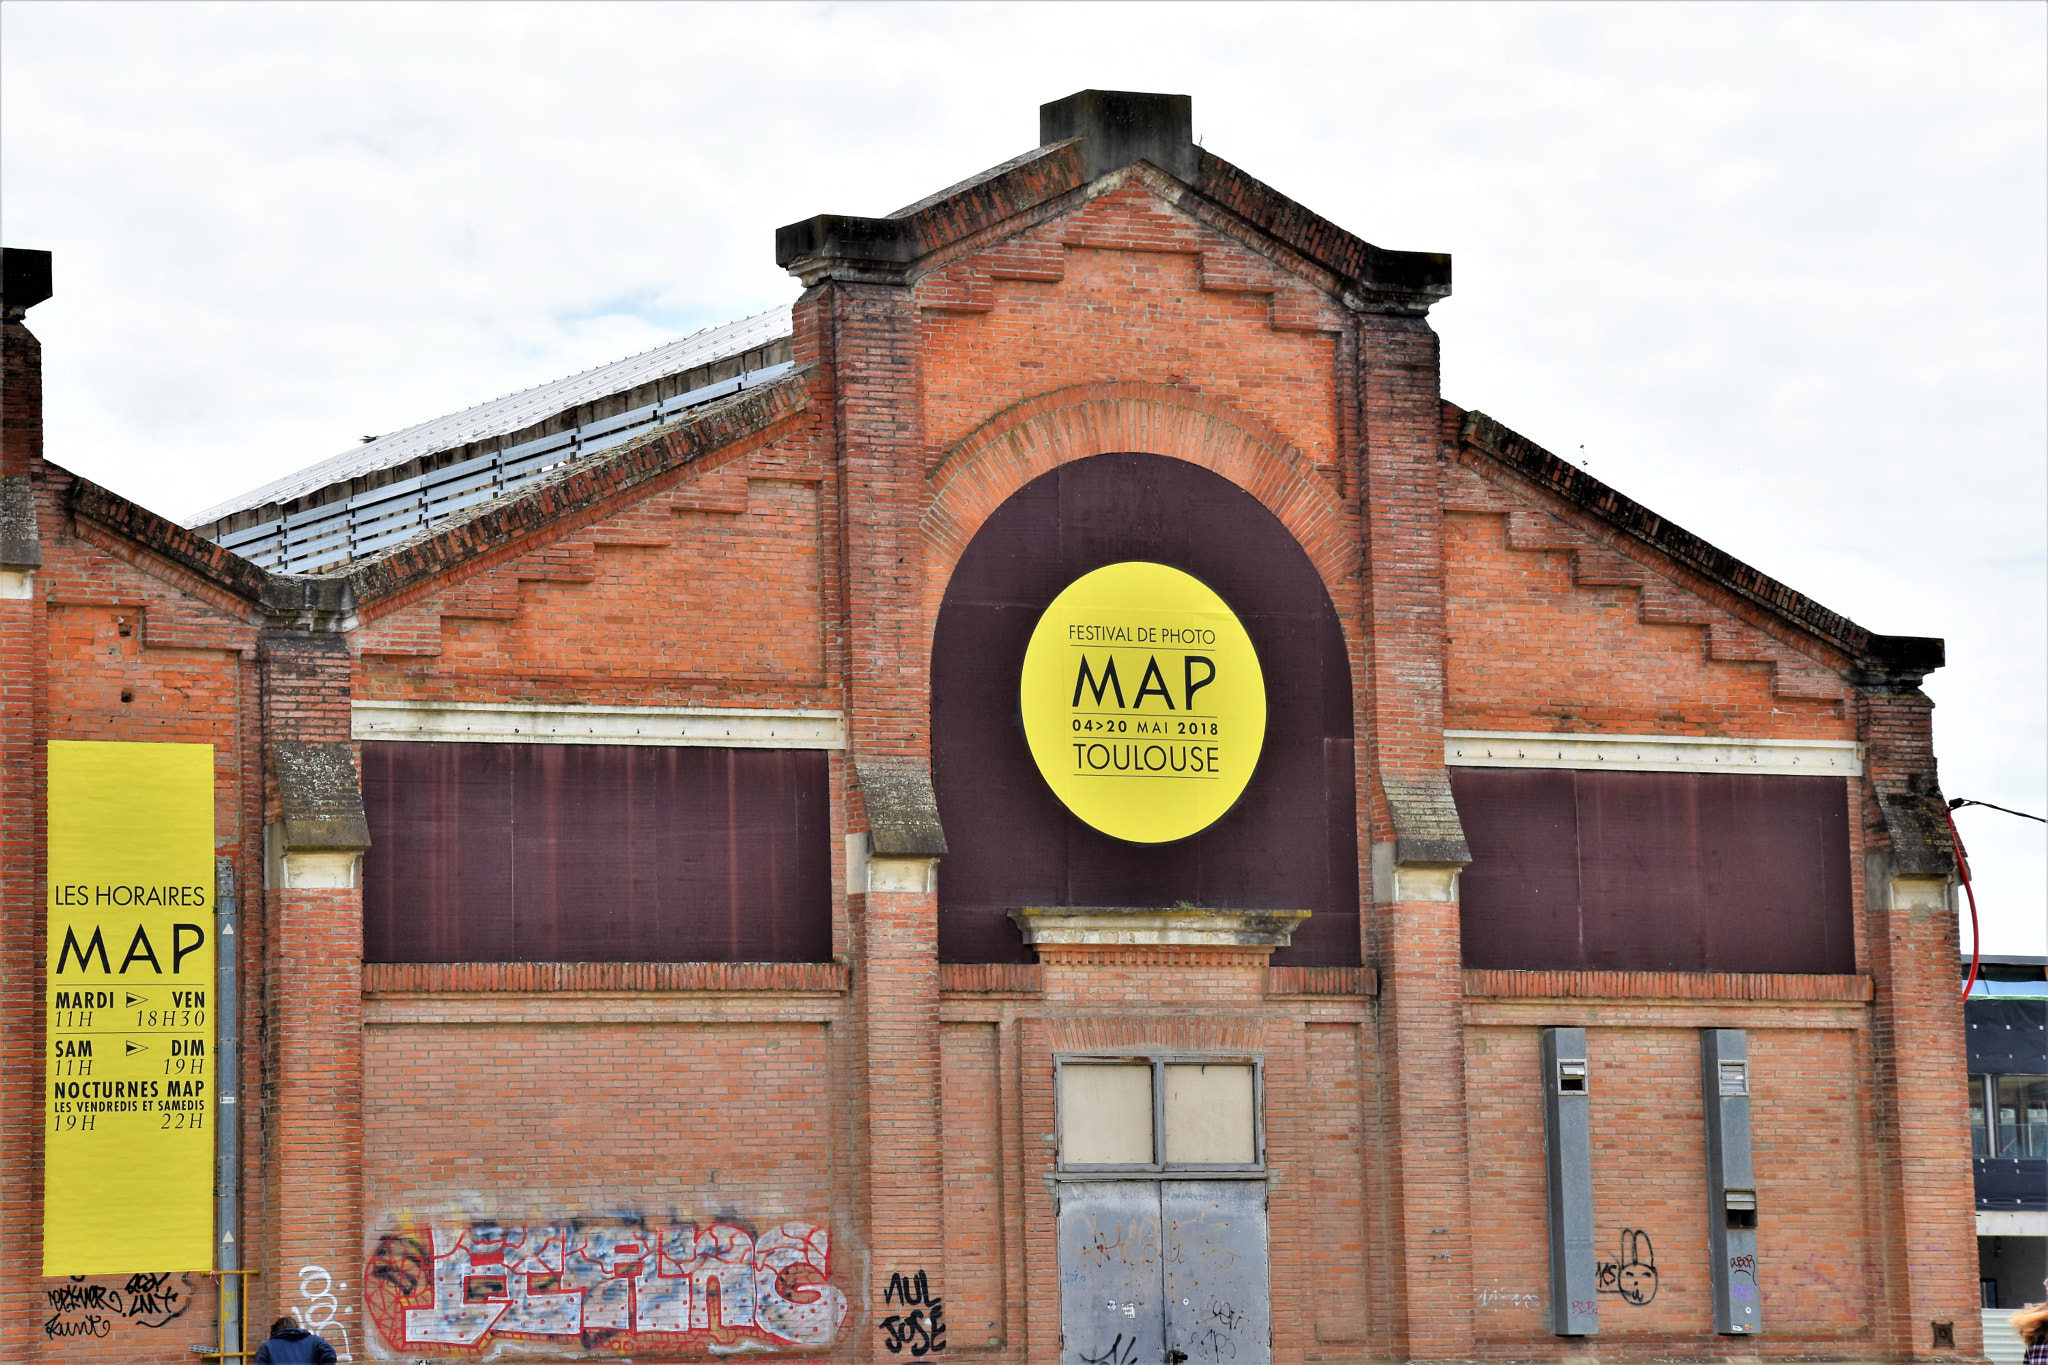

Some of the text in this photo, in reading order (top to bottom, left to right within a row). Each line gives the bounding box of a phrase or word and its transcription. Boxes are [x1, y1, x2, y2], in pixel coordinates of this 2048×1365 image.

[1069, 625, 1216, 645] FESTIVAL DE PHOTO
[1072, 653, 1216, 710] MAP
[1137, 721, 1169, 734] MAI
[1177, 722, 1218, 736] 2018
[1073, 743, 1219, 772] TOULOUSE
[55, 885, 205, 906] LES HORAIRES
[55, 923, 205, 974] MAP
[55, 991, 205, 1009] MARDI VEN
[55, 1010, 205, 1028] 11H 18H30
[55, 1039, 205, 1058] SAM DIM
[55, 1058, 204, 1076] 11H 19H
[54, 1080, 205, 1099] NOCTURNES MAP
[54, 1100, 205, 1113] LES VENDREDIS ET SAMEDIS
[54, 1112, 203, 1132] 19H 22H
